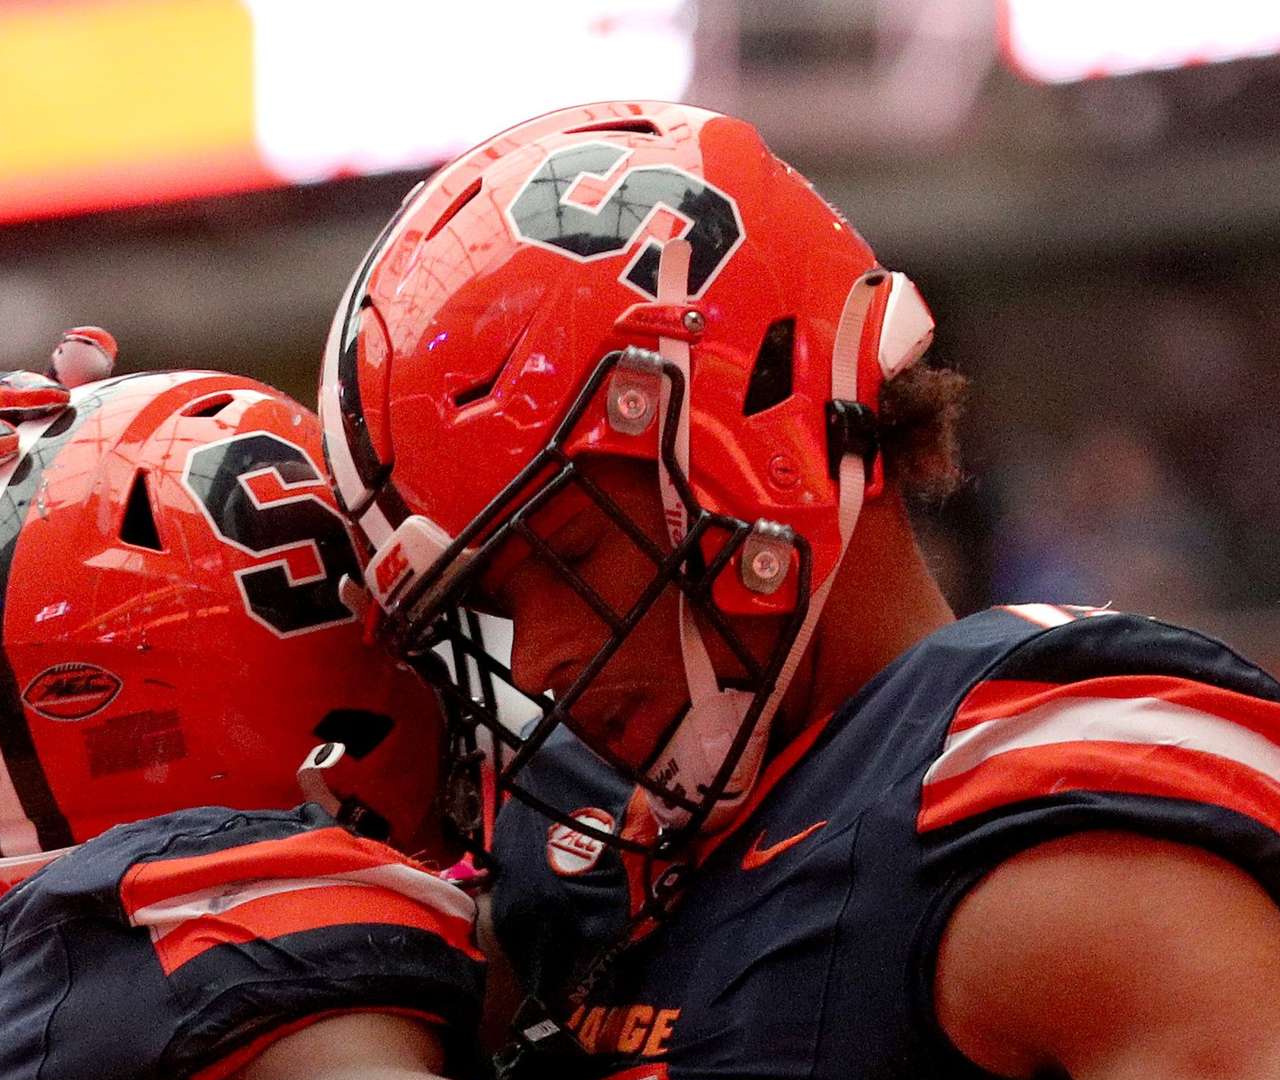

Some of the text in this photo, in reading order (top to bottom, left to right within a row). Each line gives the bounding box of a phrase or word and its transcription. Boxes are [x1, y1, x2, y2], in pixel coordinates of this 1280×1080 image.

[503, 139, 747, 304] S
[181, 430, 360, 640] S
[567, 1001, 682, 1057] ANGE
